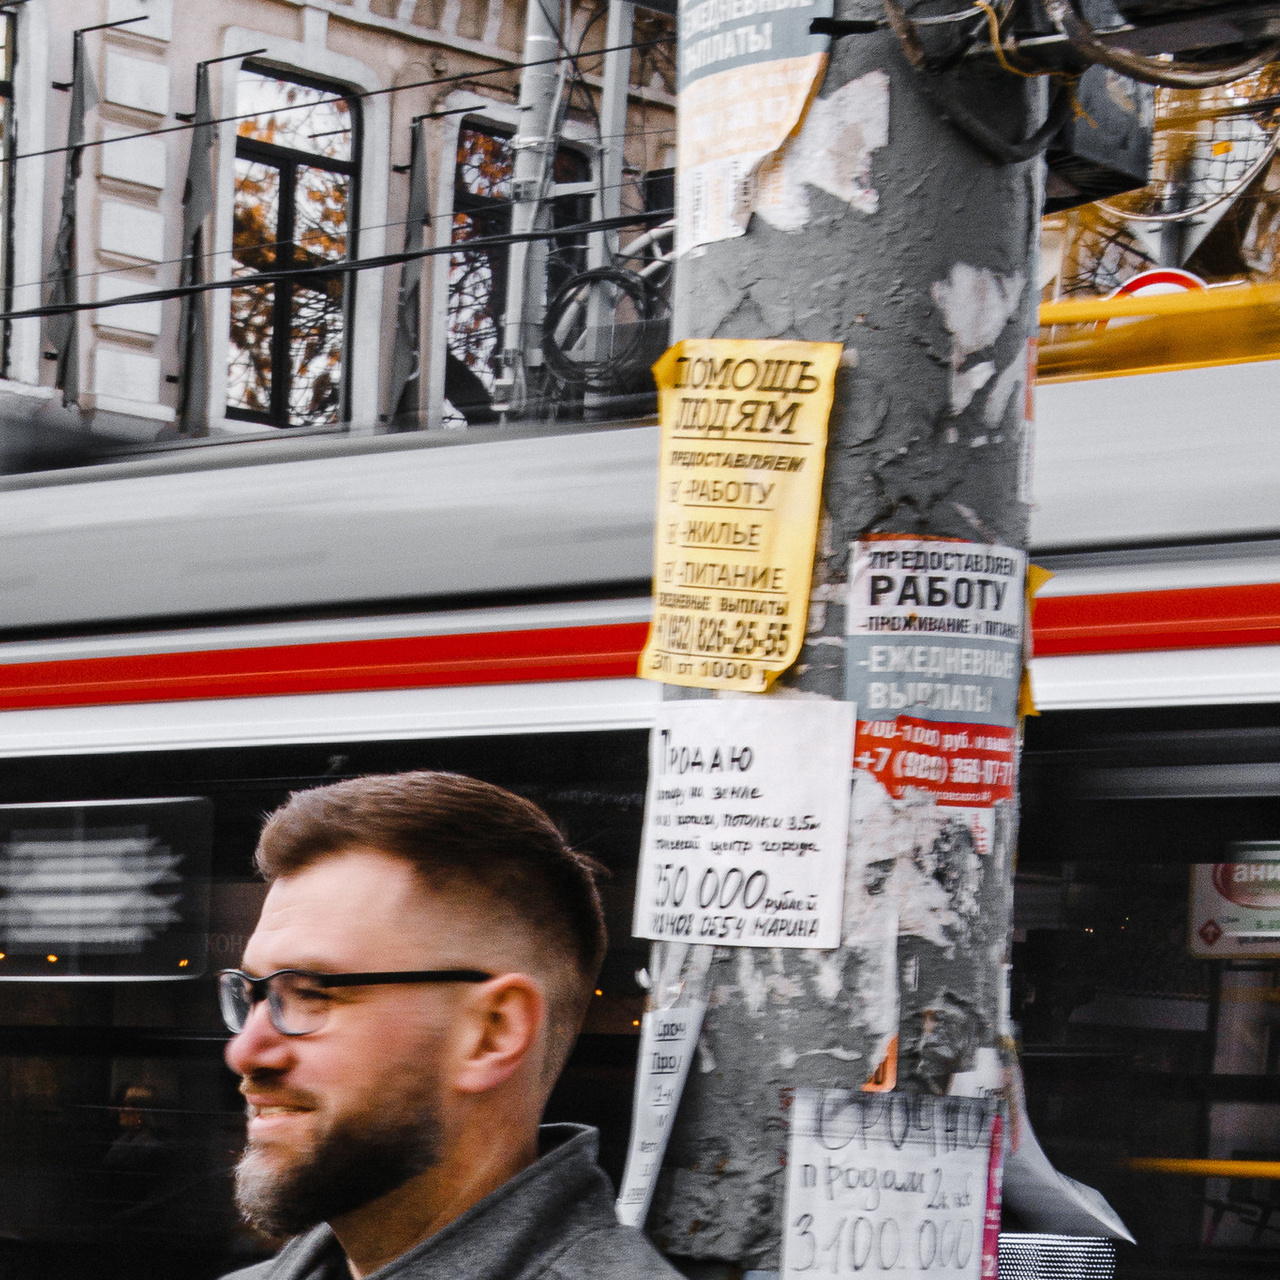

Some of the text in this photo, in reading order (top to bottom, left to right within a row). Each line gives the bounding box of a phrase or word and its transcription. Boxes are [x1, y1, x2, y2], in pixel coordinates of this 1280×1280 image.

[673, 357, 820, 399] ПОМОЩЬ
[675, 397, 804, 438] ЛЮДЯМ
[670, 450, 807, 473] ПРЕДОСТАВЛЯЕМ
[718, 597, 791, 616] ВЫПЛАТЫ
[869, 575, 1007, 612] РАБОТУ
[700, 660, 753, 680] 1000
[869, 681, 994, 713] ВЫПЛАТЫ
